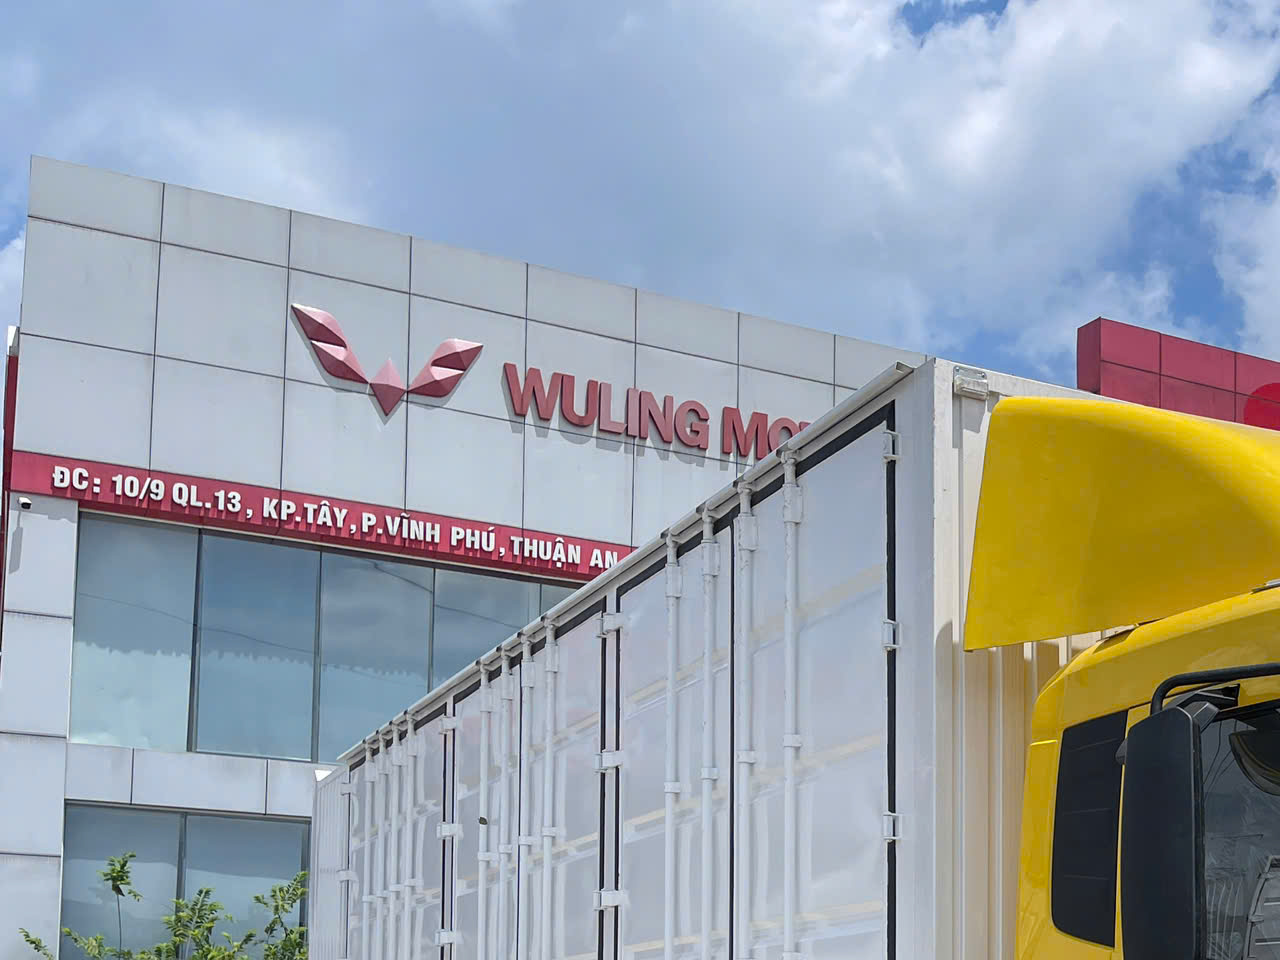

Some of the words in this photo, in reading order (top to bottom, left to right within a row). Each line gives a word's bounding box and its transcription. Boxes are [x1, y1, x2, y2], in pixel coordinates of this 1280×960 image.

[503, 362, 710, 451] WULING
[721, 406, 814, 460] MO
[112, 474, 166, 501] 10/9
[510, 535, 581, 568] THUẬN
[589, 548, 618, 569] AN
